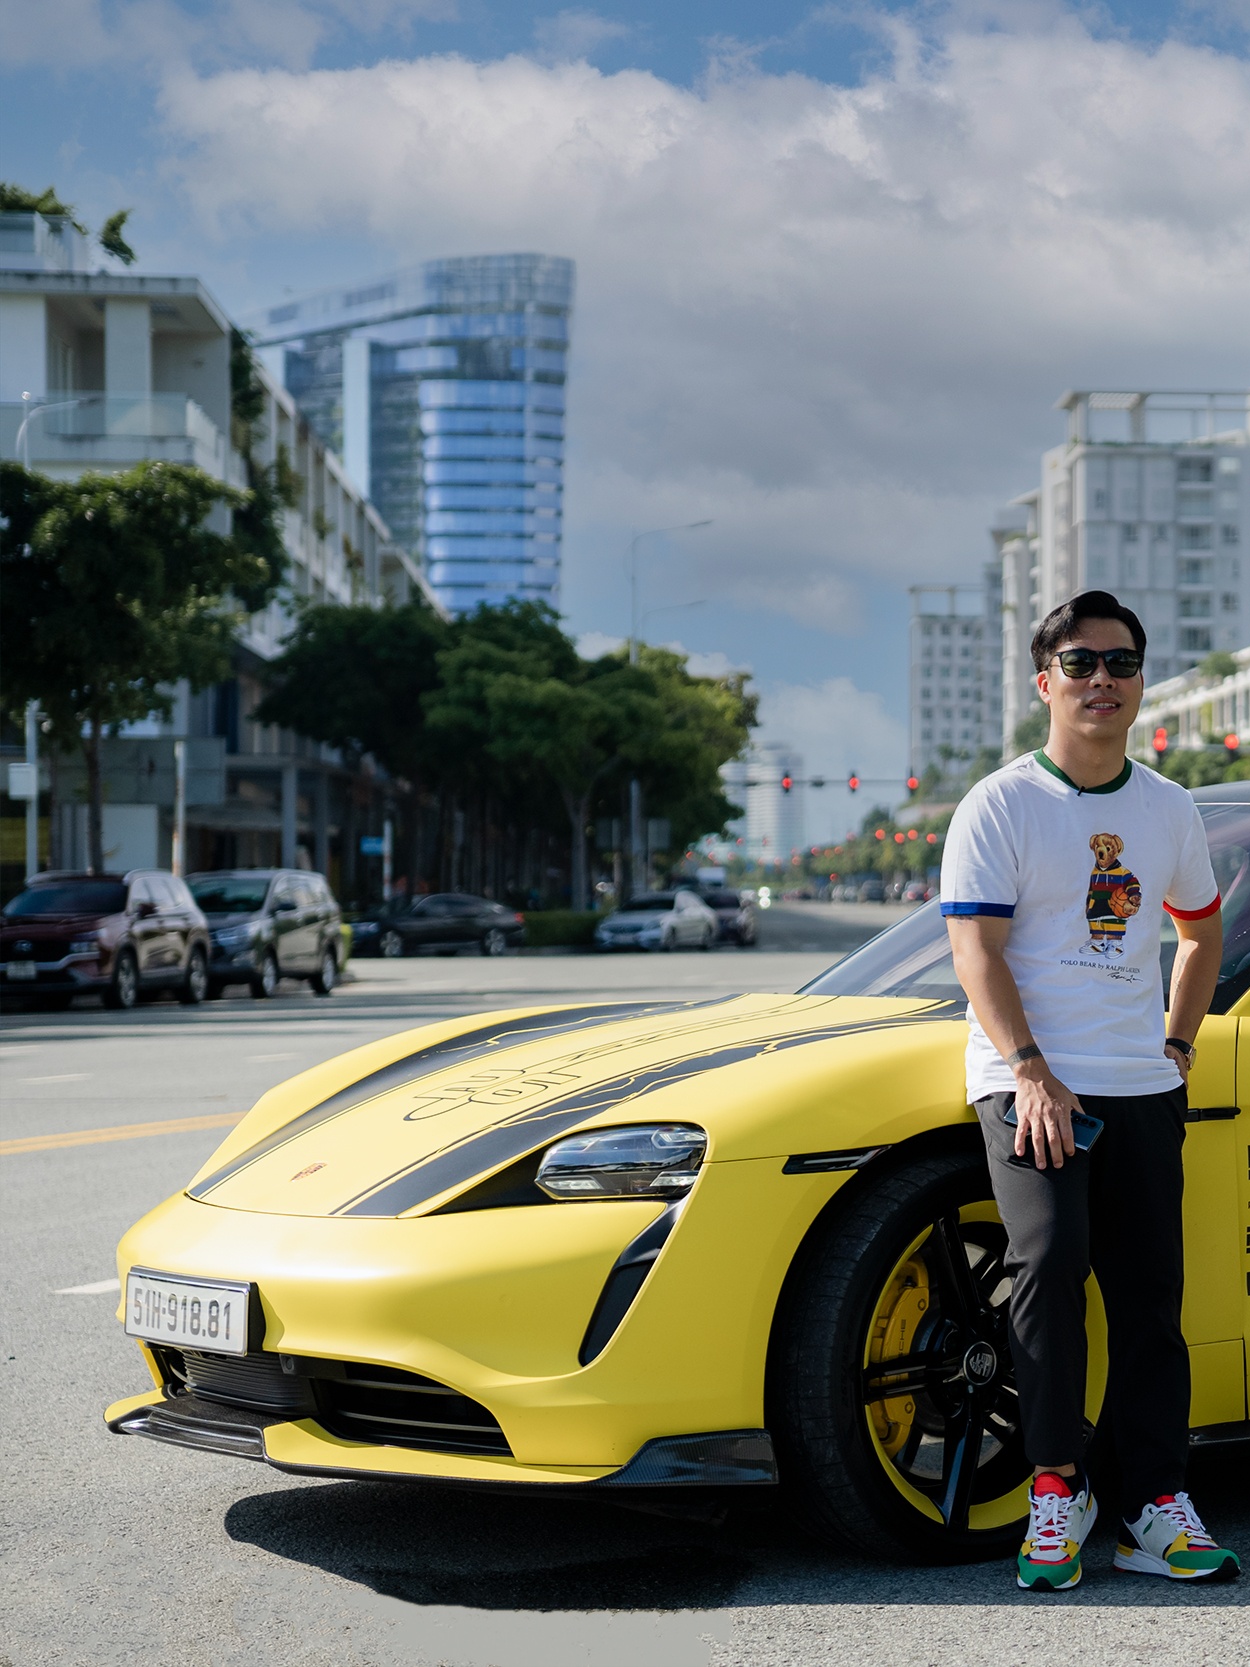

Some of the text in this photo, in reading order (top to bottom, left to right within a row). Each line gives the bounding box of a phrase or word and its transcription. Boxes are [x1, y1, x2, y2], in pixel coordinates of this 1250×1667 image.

[1080, 960, 1096, 968] BEAR
[1105, 964, 1125, 973] RALPH
[133, 1287, 232, 1340] 51H-918.81
